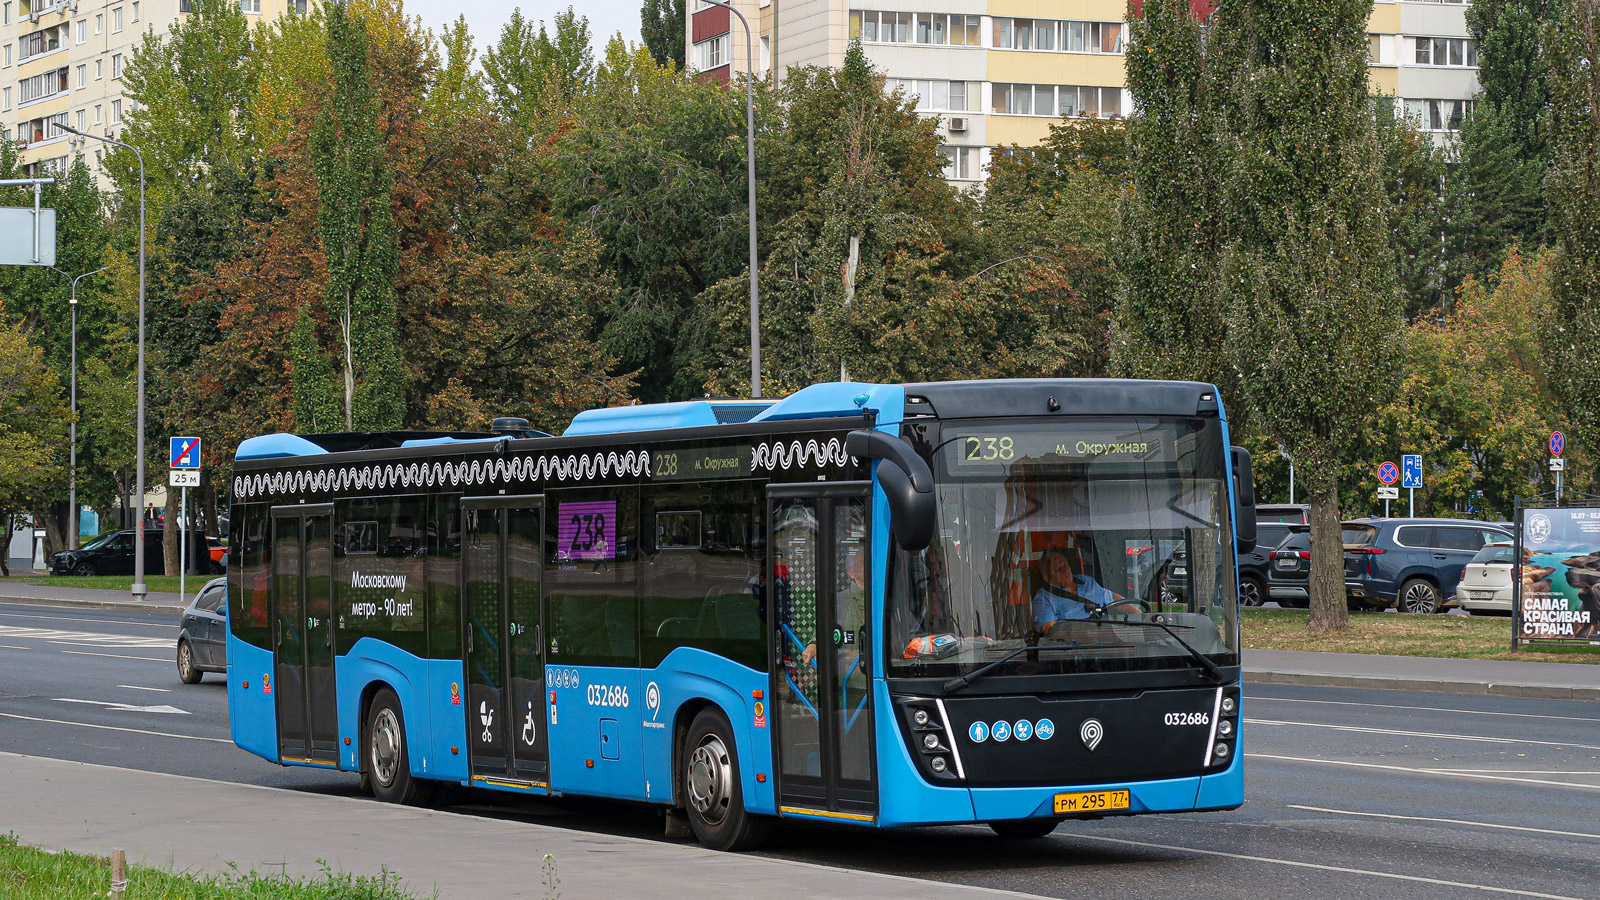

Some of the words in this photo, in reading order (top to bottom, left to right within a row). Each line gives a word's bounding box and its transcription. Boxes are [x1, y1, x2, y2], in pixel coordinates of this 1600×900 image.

[965, 436, 1014, 461] 238
[1055, 444, 1070, 455] м.
[1075, 441, 1148, 456] Окружная
[656, 453, 678, 476] 238
[703, 457, 739, 471] Окружная
[174, 474, 187, 483] 25
[571, 513, 605, 551] 238
[351, 571, 407, 592] Московскому
[351, 603, 377, 620] метро
[384, 598, 396, 616] 90
[396, 598, 413, 617] лет!
[1524, 598, 1569, 611] САМАЯ
[1523, 610, 1591, 624] КРАСИВАЯ
[1523, 622, 1574, 636] СТРАНА
[587, 684, 630, 708] 032686
[1164, 712, 1210, 726] 032686
[1081, 794, 1106, 809] 295
[1112, 792, 1125, 803] 77
